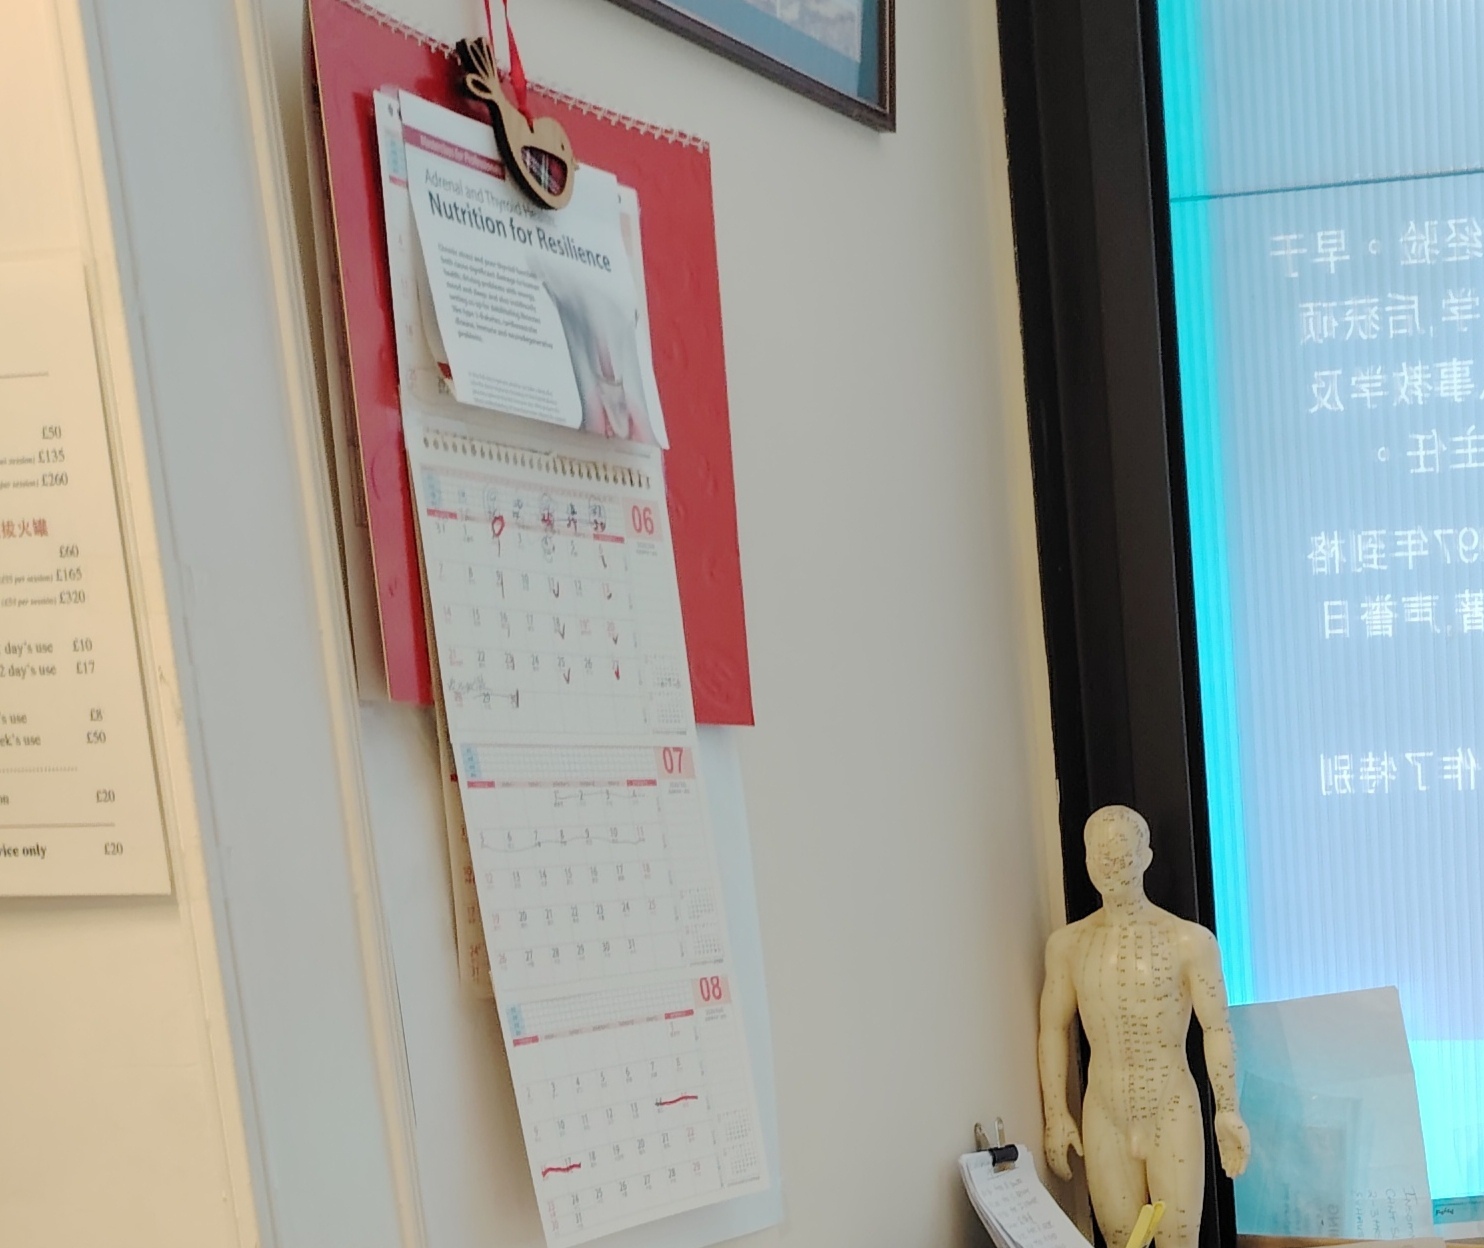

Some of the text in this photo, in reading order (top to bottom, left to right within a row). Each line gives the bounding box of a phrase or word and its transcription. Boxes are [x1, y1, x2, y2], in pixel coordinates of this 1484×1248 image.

[425, 168, 463, 196] Adrenal
[465, 186, 485, 202] and
[429, 191, 507, 240] Nutrition
[510, 217, 533, 246] for
[536, 226, 612, 272] Resilience
[42, 425, 62, 440] £50
[38, 450, 65, 464] £135
[41, 472, 69, 488] £260
[631, 504, 656, 535] 06
[56, 568, 83, 582] £165
[59, 590, 86, 605] £320
[5, 638, 93, 658] day's use £10
[8, 663, 37, 680] day's
[38, 665, 57, 676] use
[76, 661, 95, 675] £17
[10, 713, 28, 724] use
[23, 735, 41, 746] use
[87, 731, 107, 744] £50
[662, 747, 685, 775] 07
[96, 789, 116, 803] £20
[22, 843, 47, 860] only
[104, 842, 124, 856] £20
[699, 975, 723, 1002] 08
